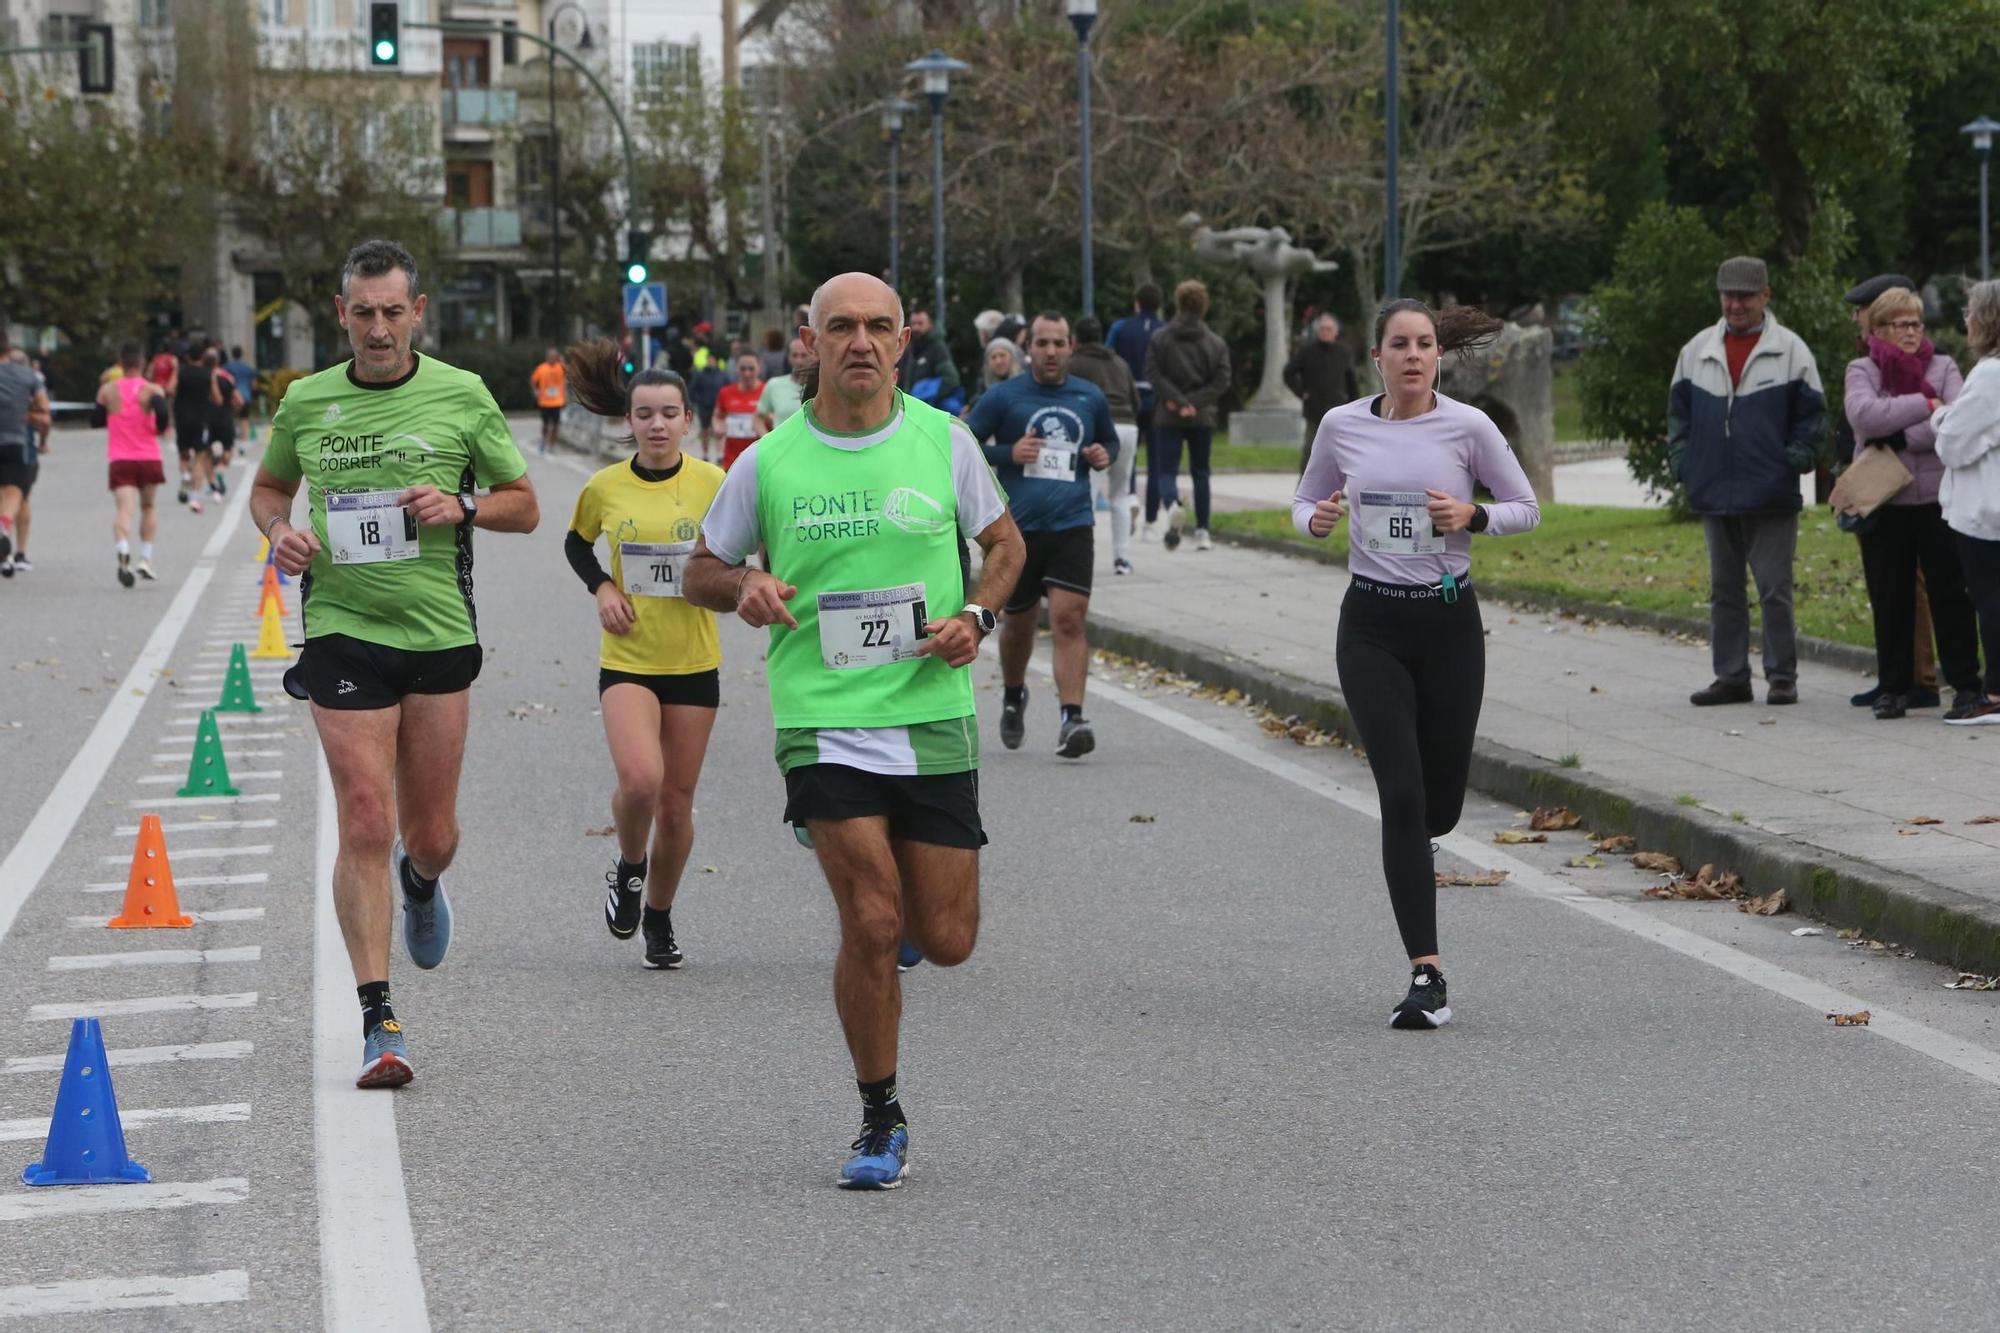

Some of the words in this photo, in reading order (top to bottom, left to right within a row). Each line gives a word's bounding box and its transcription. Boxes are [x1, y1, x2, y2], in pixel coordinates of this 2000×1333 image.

[320, 435, 384, 454] PONTE
[319, 455, 382, 472] CORRER
[1043, 455, 1059, 470] 53
[793, 489, 879, 519] PONTE
[360, 521, 380, 546] 18
[795, 518, 880, 543] CORRER
[1389, 517, 1412, 538] 66
[650, 564, 673, 582] 70
[1376, 586, 1406, 599] YOUR
[1410, 589, 1441, 599] GOAL
[861, 620, 890, 648] 22
